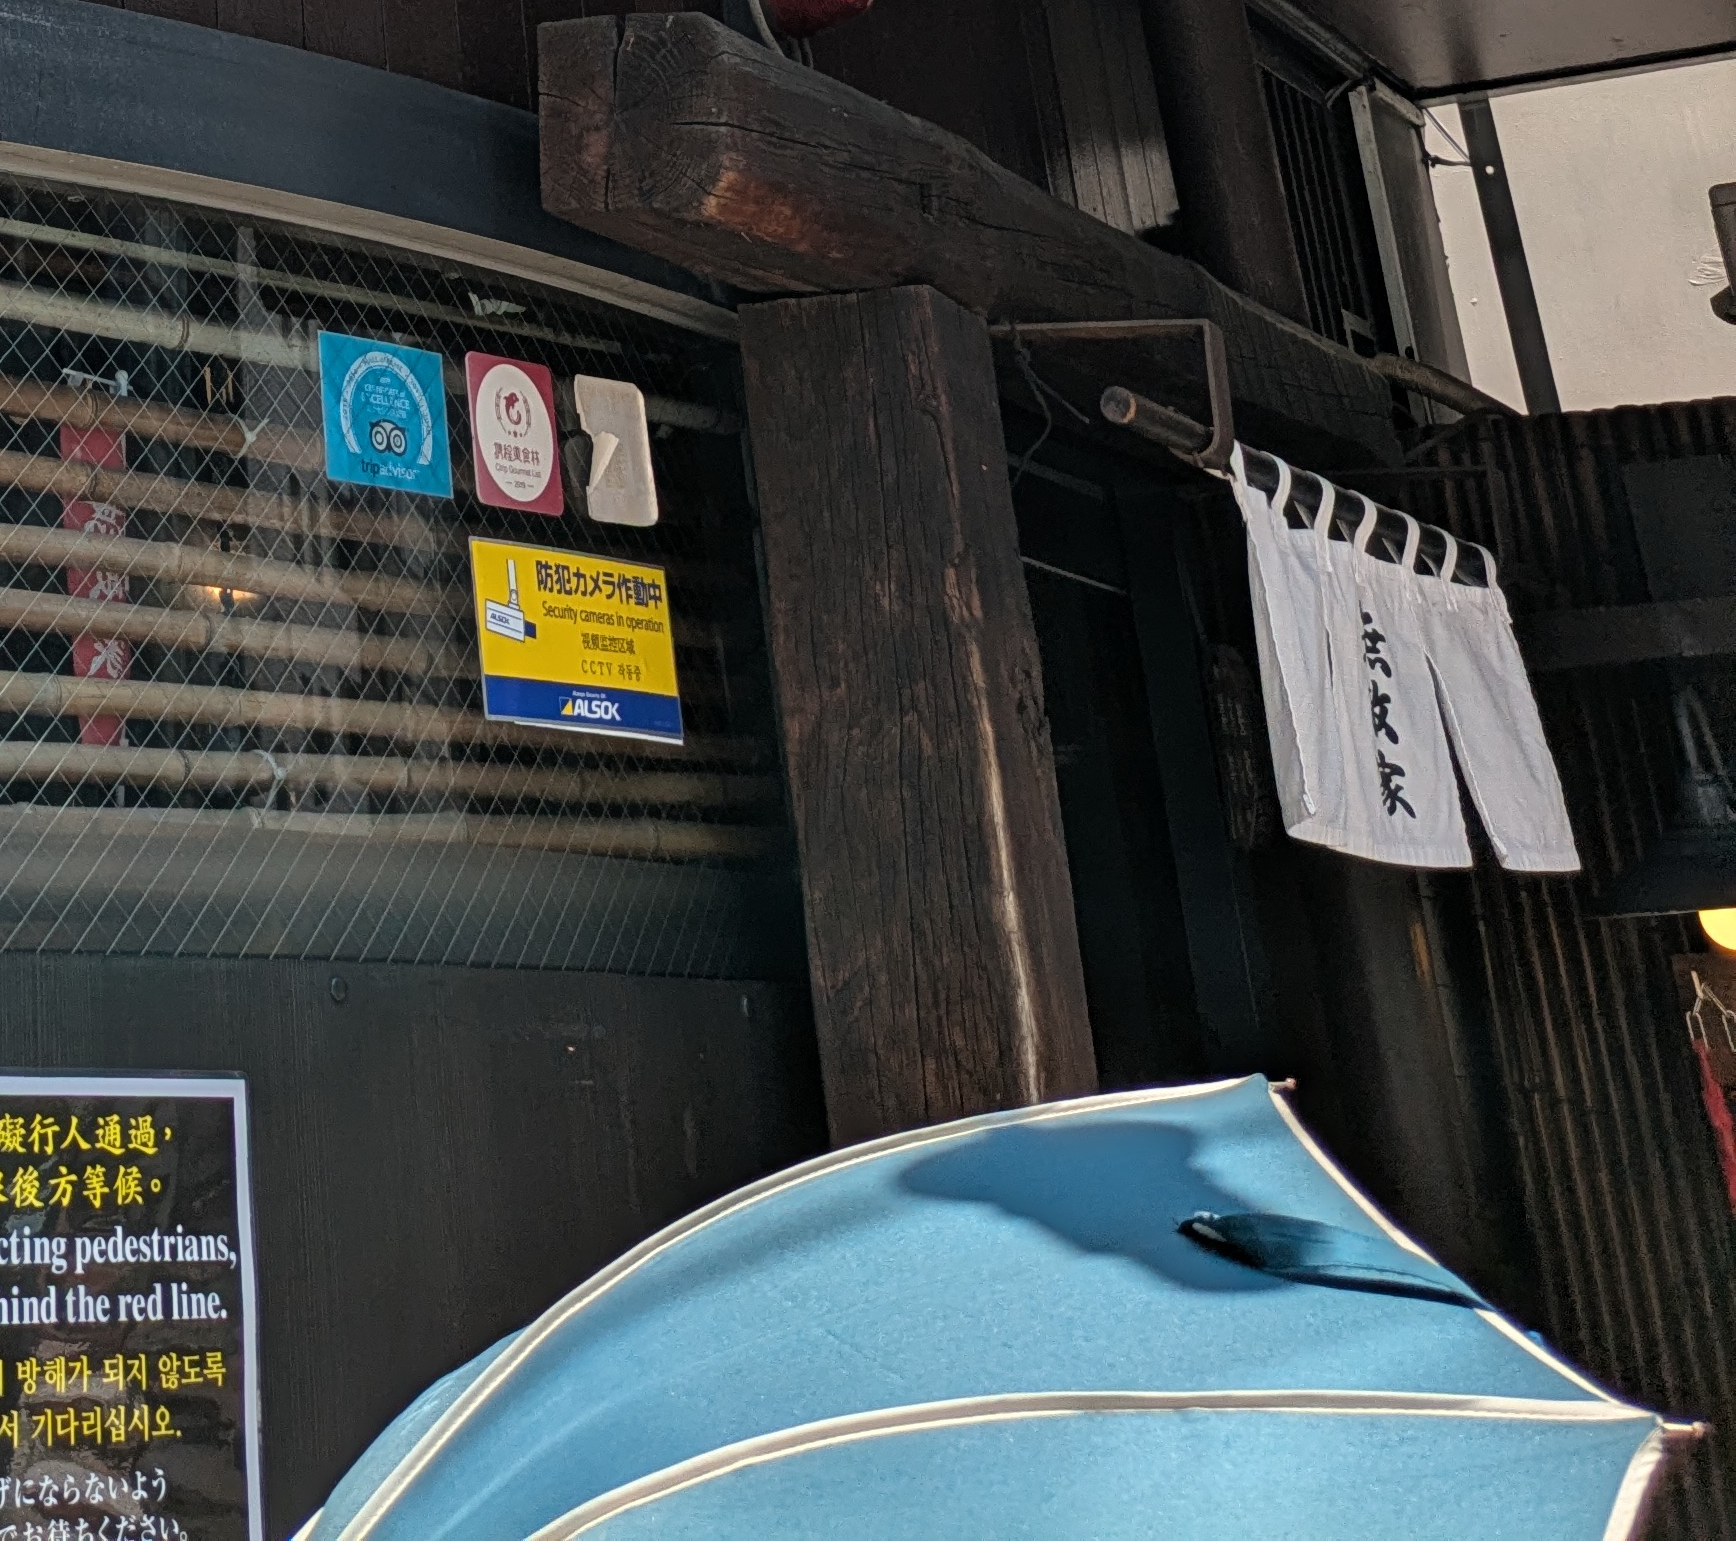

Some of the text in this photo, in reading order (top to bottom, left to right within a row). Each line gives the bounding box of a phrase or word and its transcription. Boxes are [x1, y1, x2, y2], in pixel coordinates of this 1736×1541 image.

[535, 559, 663, 610] 防犯カメラ作動中
[542, 601, 664, 634] Security cameras in operation
[581, 660, 613, 676] CCTV
[573, 698, 622, 721] ALSOK
[74, 1224, 236, 1275] pedestrians,
[65, 1287, 110, 1324] the
[118, 1283, 163, 1322] red
[171, 1282, 228, 1321] line.
[16, 1355, 92, 1394] 방해가
[101, 1353, 148, 1392] 되지
[158, 1351, 226, 1391] 않도록
[32, 1405, 182, 1448] 기다리십시오.
